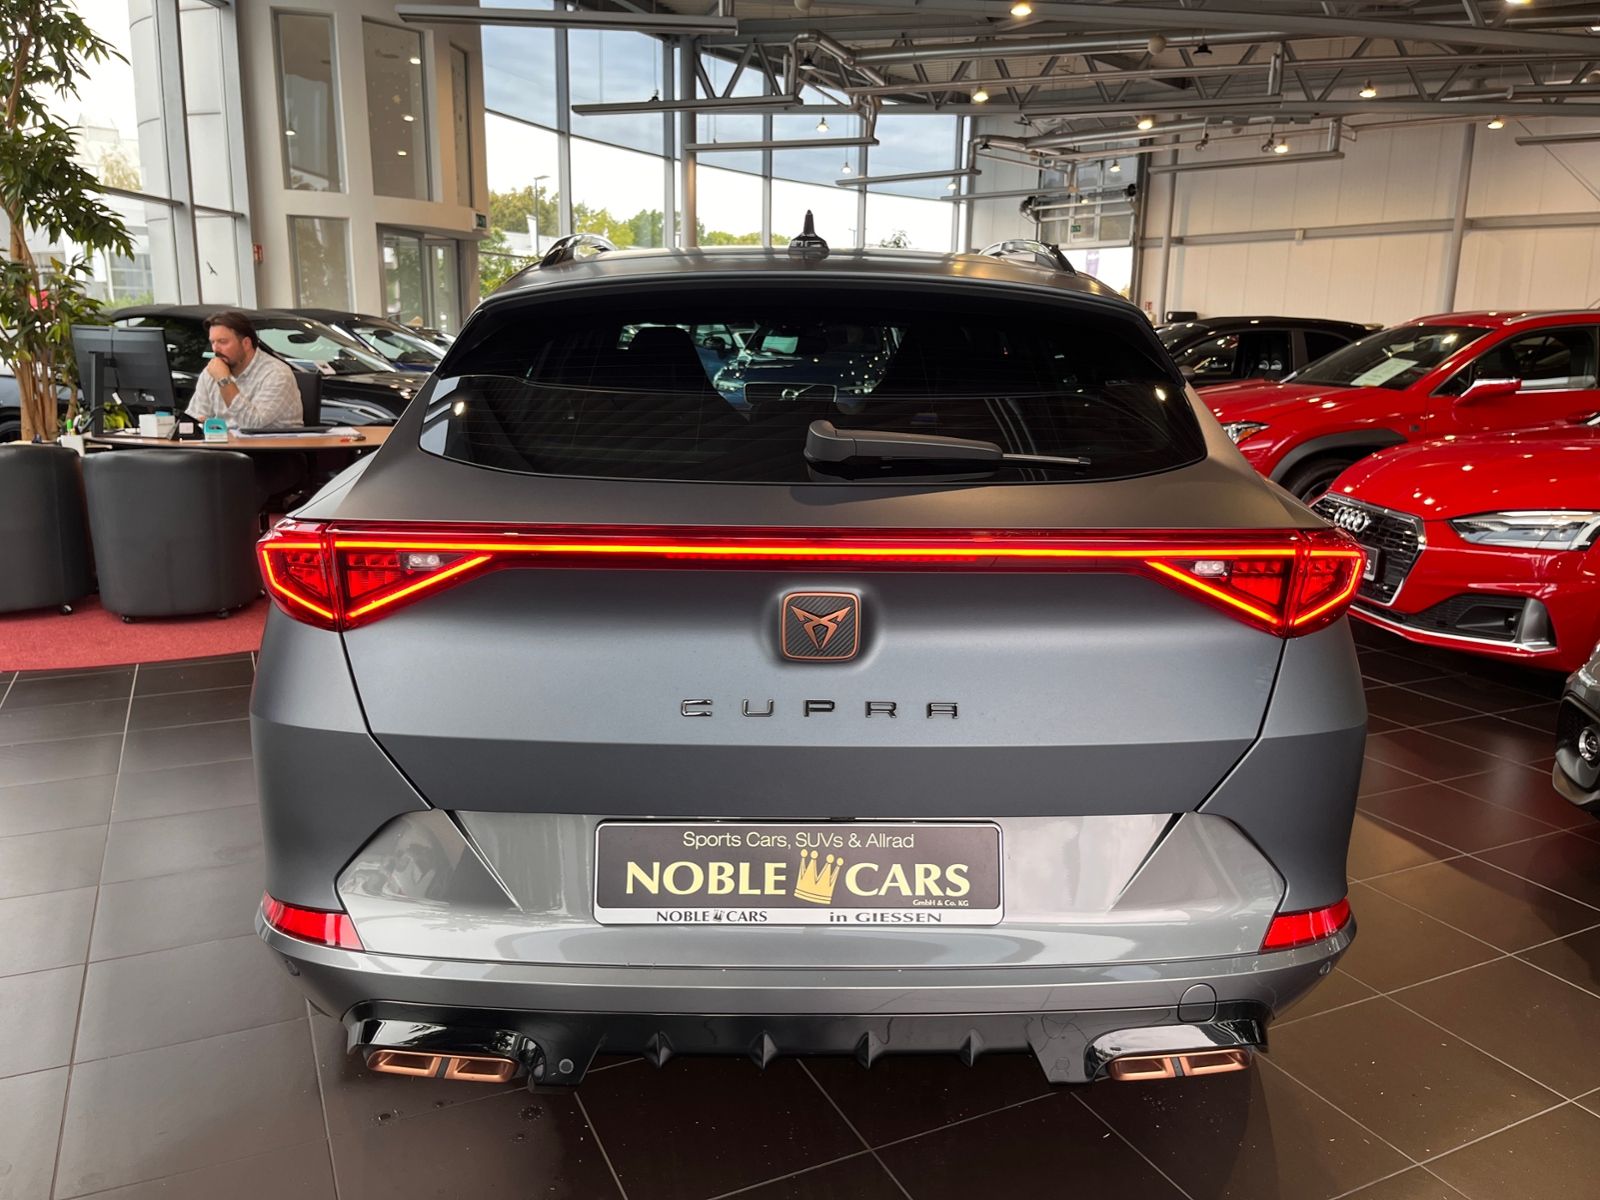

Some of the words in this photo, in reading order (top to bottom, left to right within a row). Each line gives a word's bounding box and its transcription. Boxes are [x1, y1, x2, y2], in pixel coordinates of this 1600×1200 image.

[680, 699, 959, 719] CUPRA
[683, 831, 742, 850] Sports
[746, 832, 791, 850] Cars,
[795, 832, 843, 848] SUVs
[848, 833, 862, 848] &
[866, 833, 915, 848] Allrad
[626, 861, 787, 895] NOBLE
[845, 862, 971, 897] CARS
[912, 899, 936, 907] GmbH
[944, 899, 957, 907] Co.
[656, 910, 710, 922] NOBLE
[726, 910, 768, 922] CARS
[829, 911, 848, 923] in
[855, 912, 942, 923] GIESSEN
